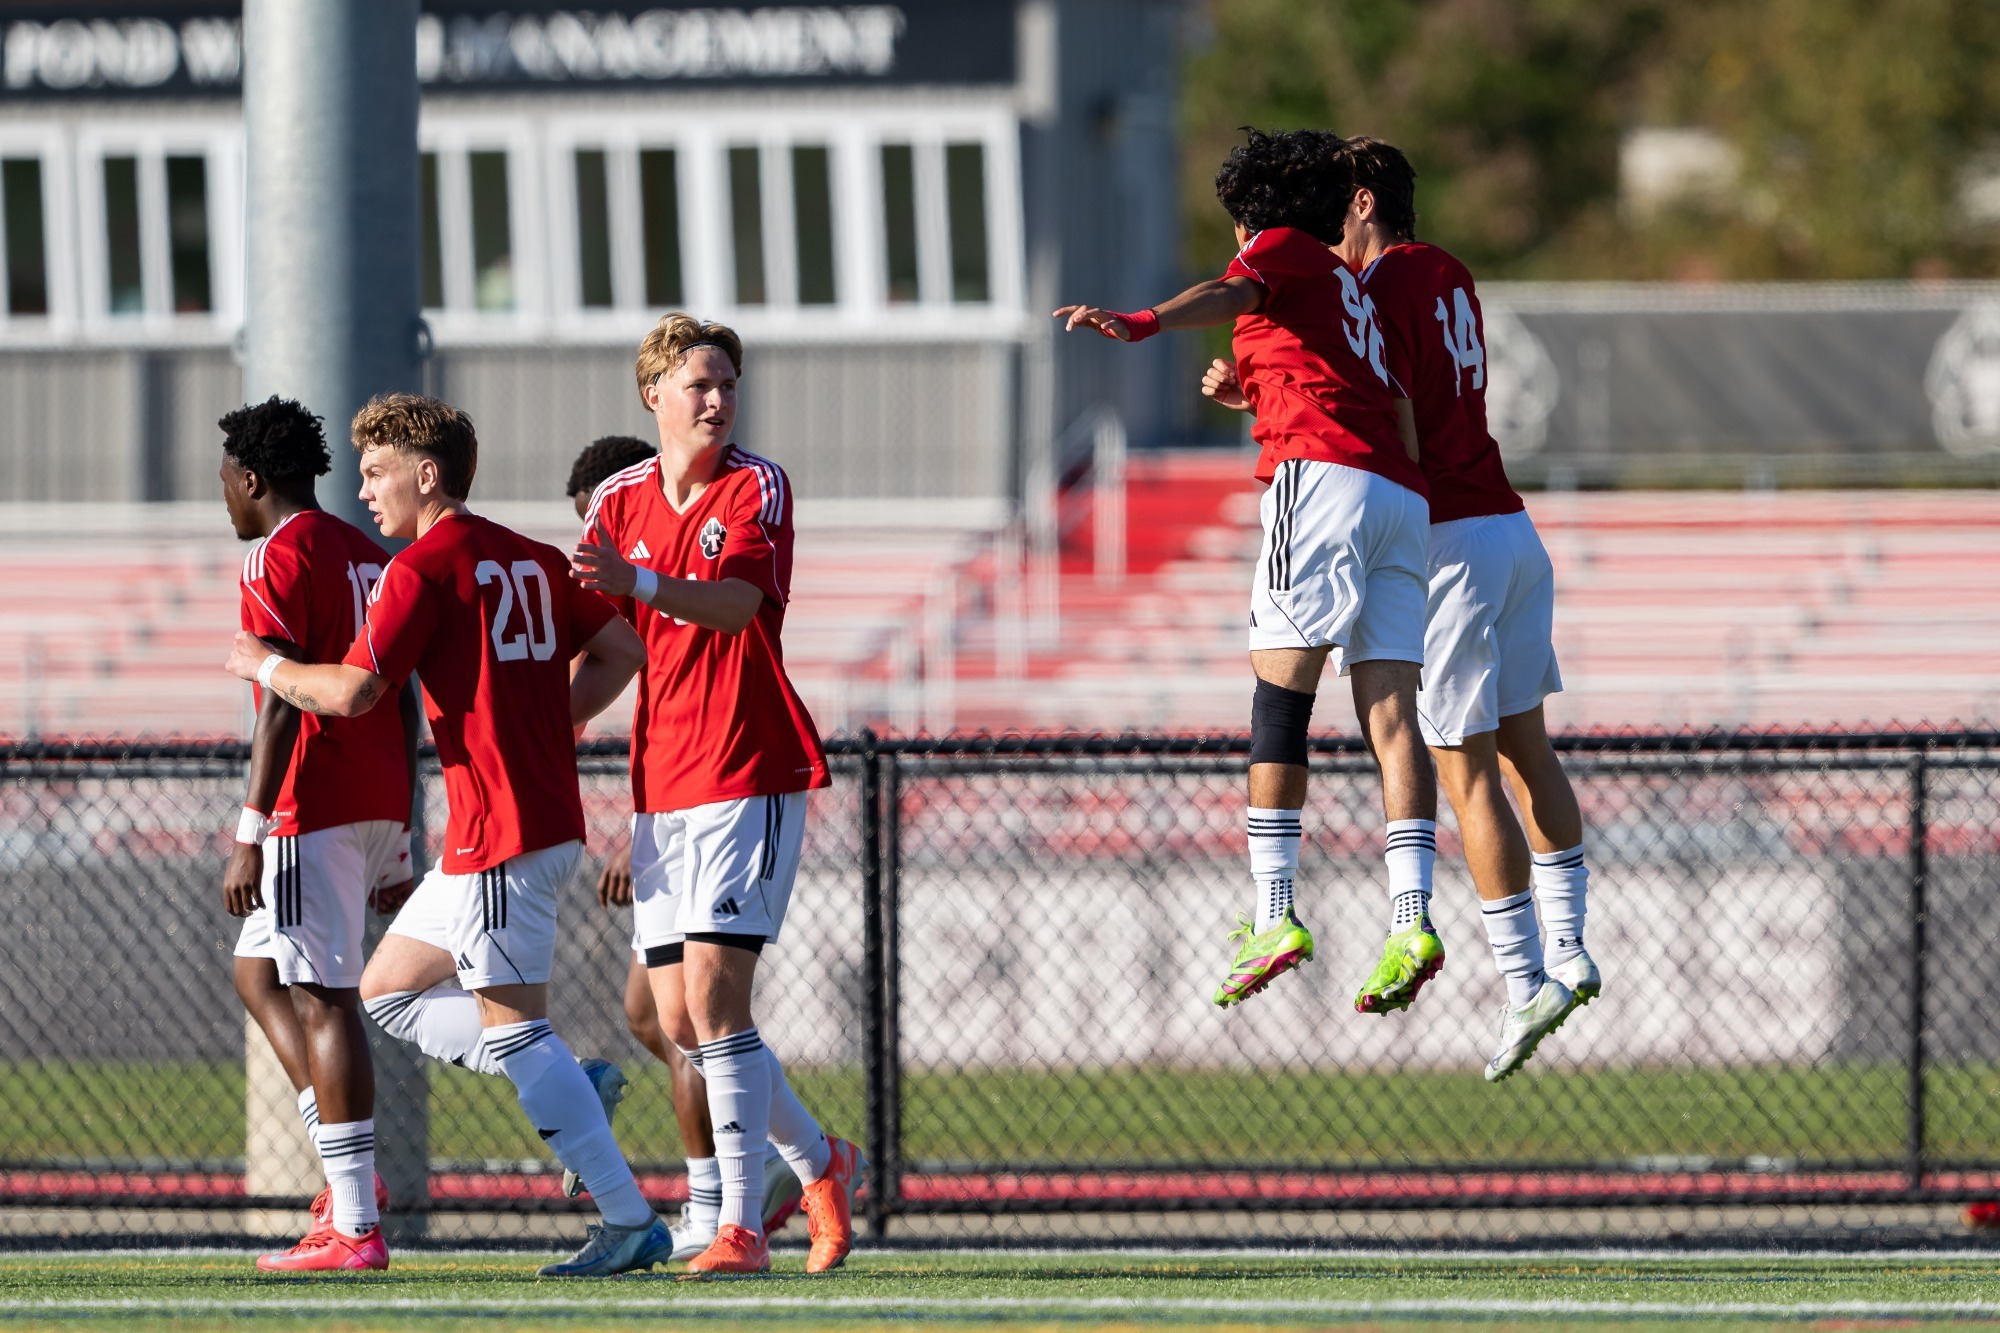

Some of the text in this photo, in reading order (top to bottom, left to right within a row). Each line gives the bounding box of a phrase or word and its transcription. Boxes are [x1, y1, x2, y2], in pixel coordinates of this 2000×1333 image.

[4, 19, 180, 89] POND
[450, 6, 907, 82] MANAGEMENT
[1434, 286, 1484, 397] 14
[475, 560, 557, 662] 20
